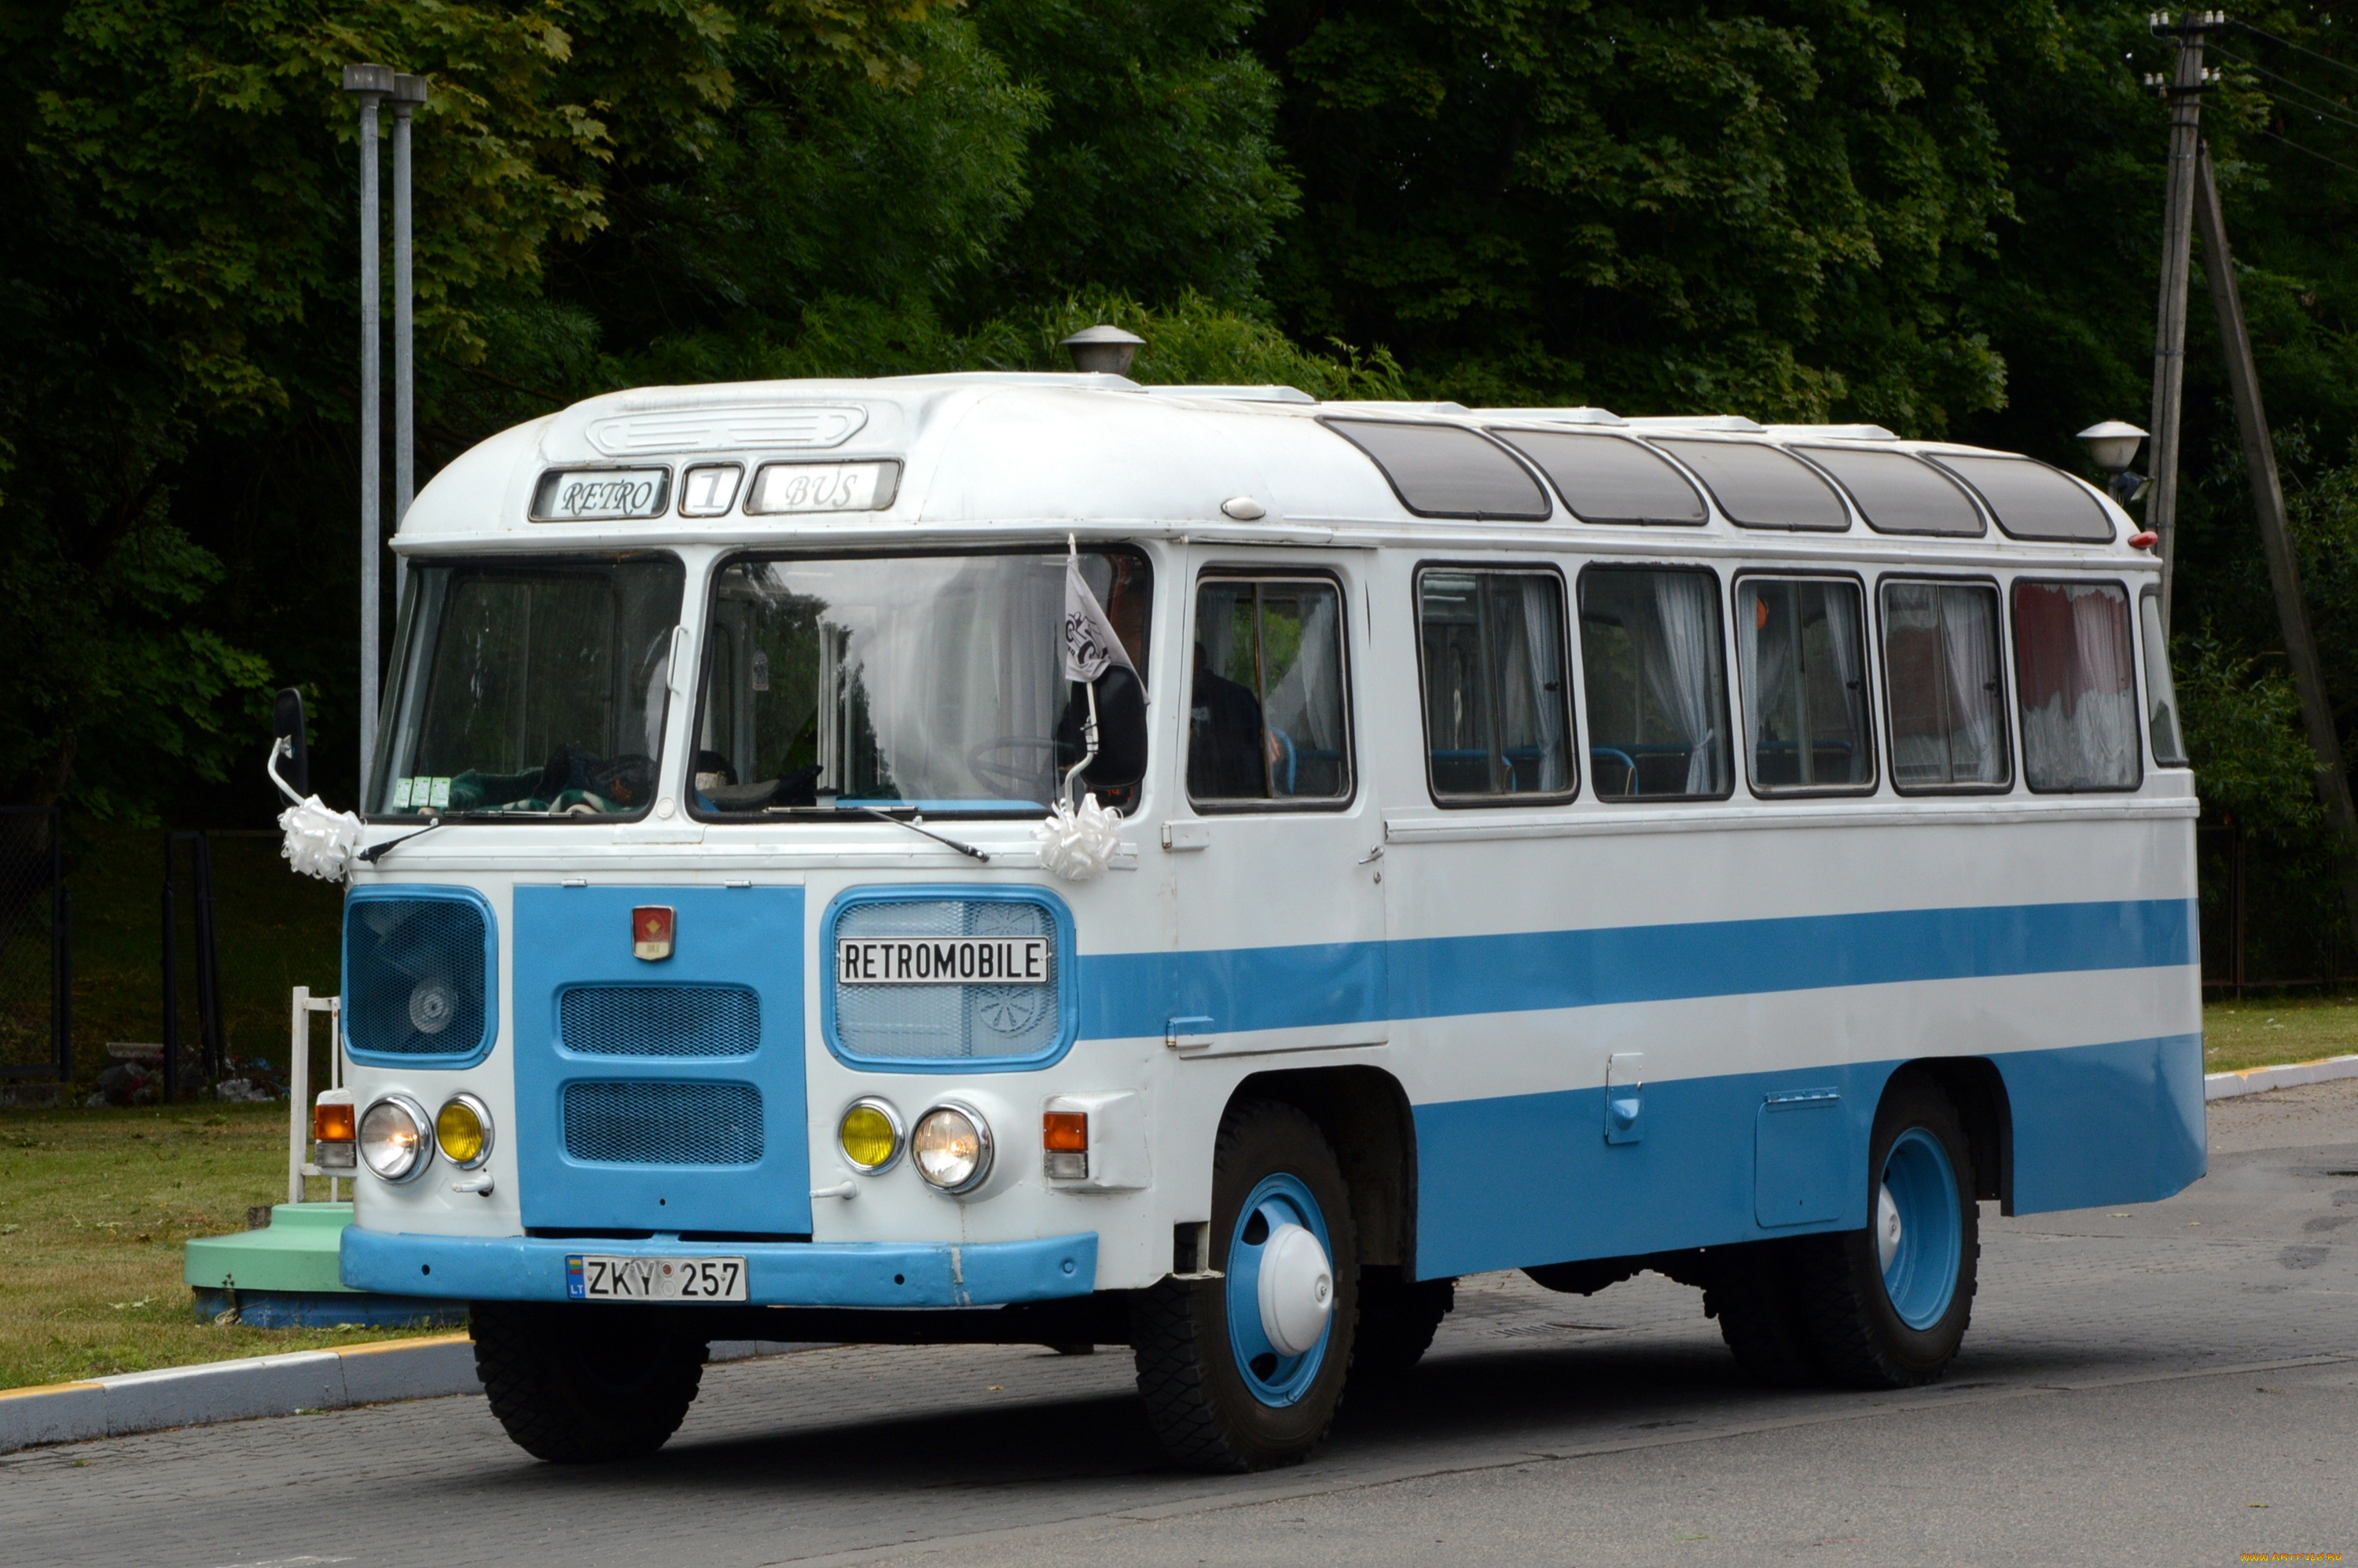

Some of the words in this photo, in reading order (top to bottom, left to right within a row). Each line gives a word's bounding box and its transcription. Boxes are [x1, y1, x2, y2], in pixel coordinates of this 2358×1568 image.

[561, 476, 653, 516] RETRO
[692, 471, 725, 509] 1
[784, 470, 858, 508] BUS
[845, 942, 1041, 979] RETROMOBILE
[571, 1284, 583, 1294] LT
[587, 1261, 655, 1295] ZKY
[679, 1262, 740, 1296] 257
